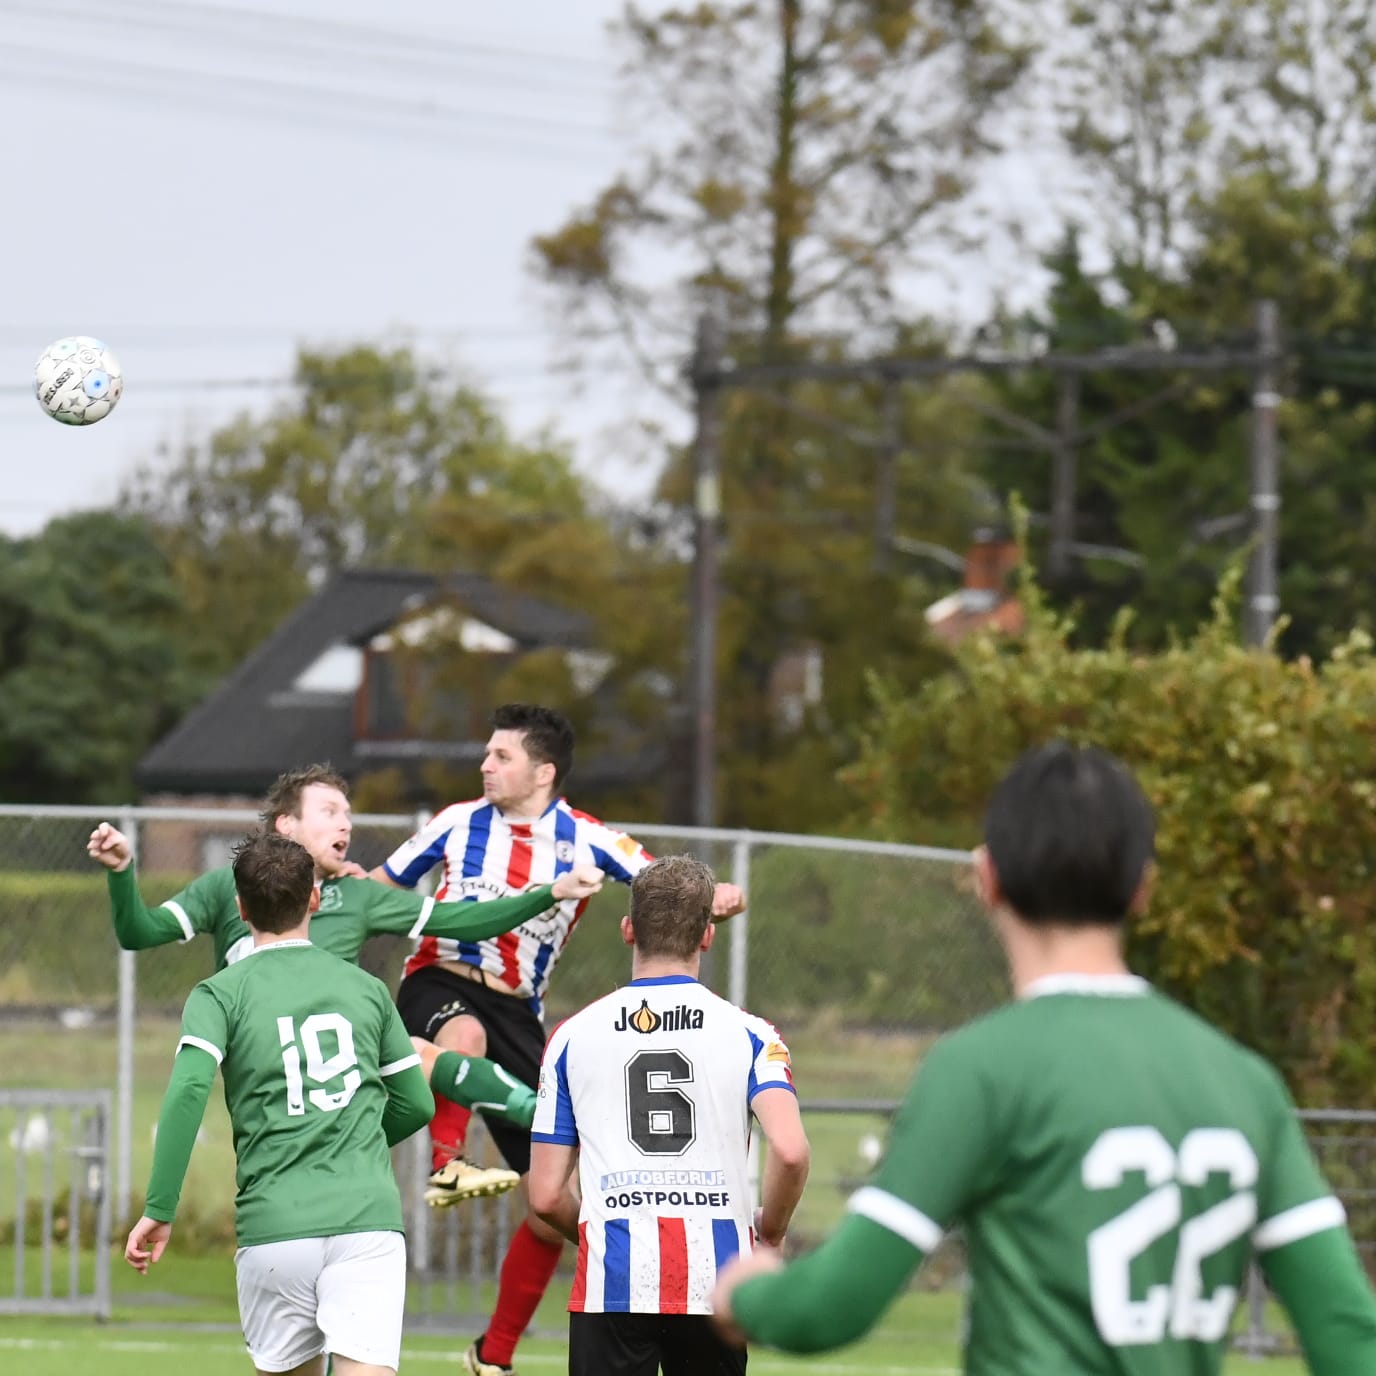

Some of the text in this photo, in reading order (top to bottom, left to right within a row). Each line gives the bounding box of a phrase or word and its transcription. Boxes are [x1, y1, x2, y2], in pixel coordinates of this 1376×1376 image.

[276, 1013, 361, 1116] 19
[624, 1048, 697, 1157] 6
[1081, 1125, 1259, 1347] 22
